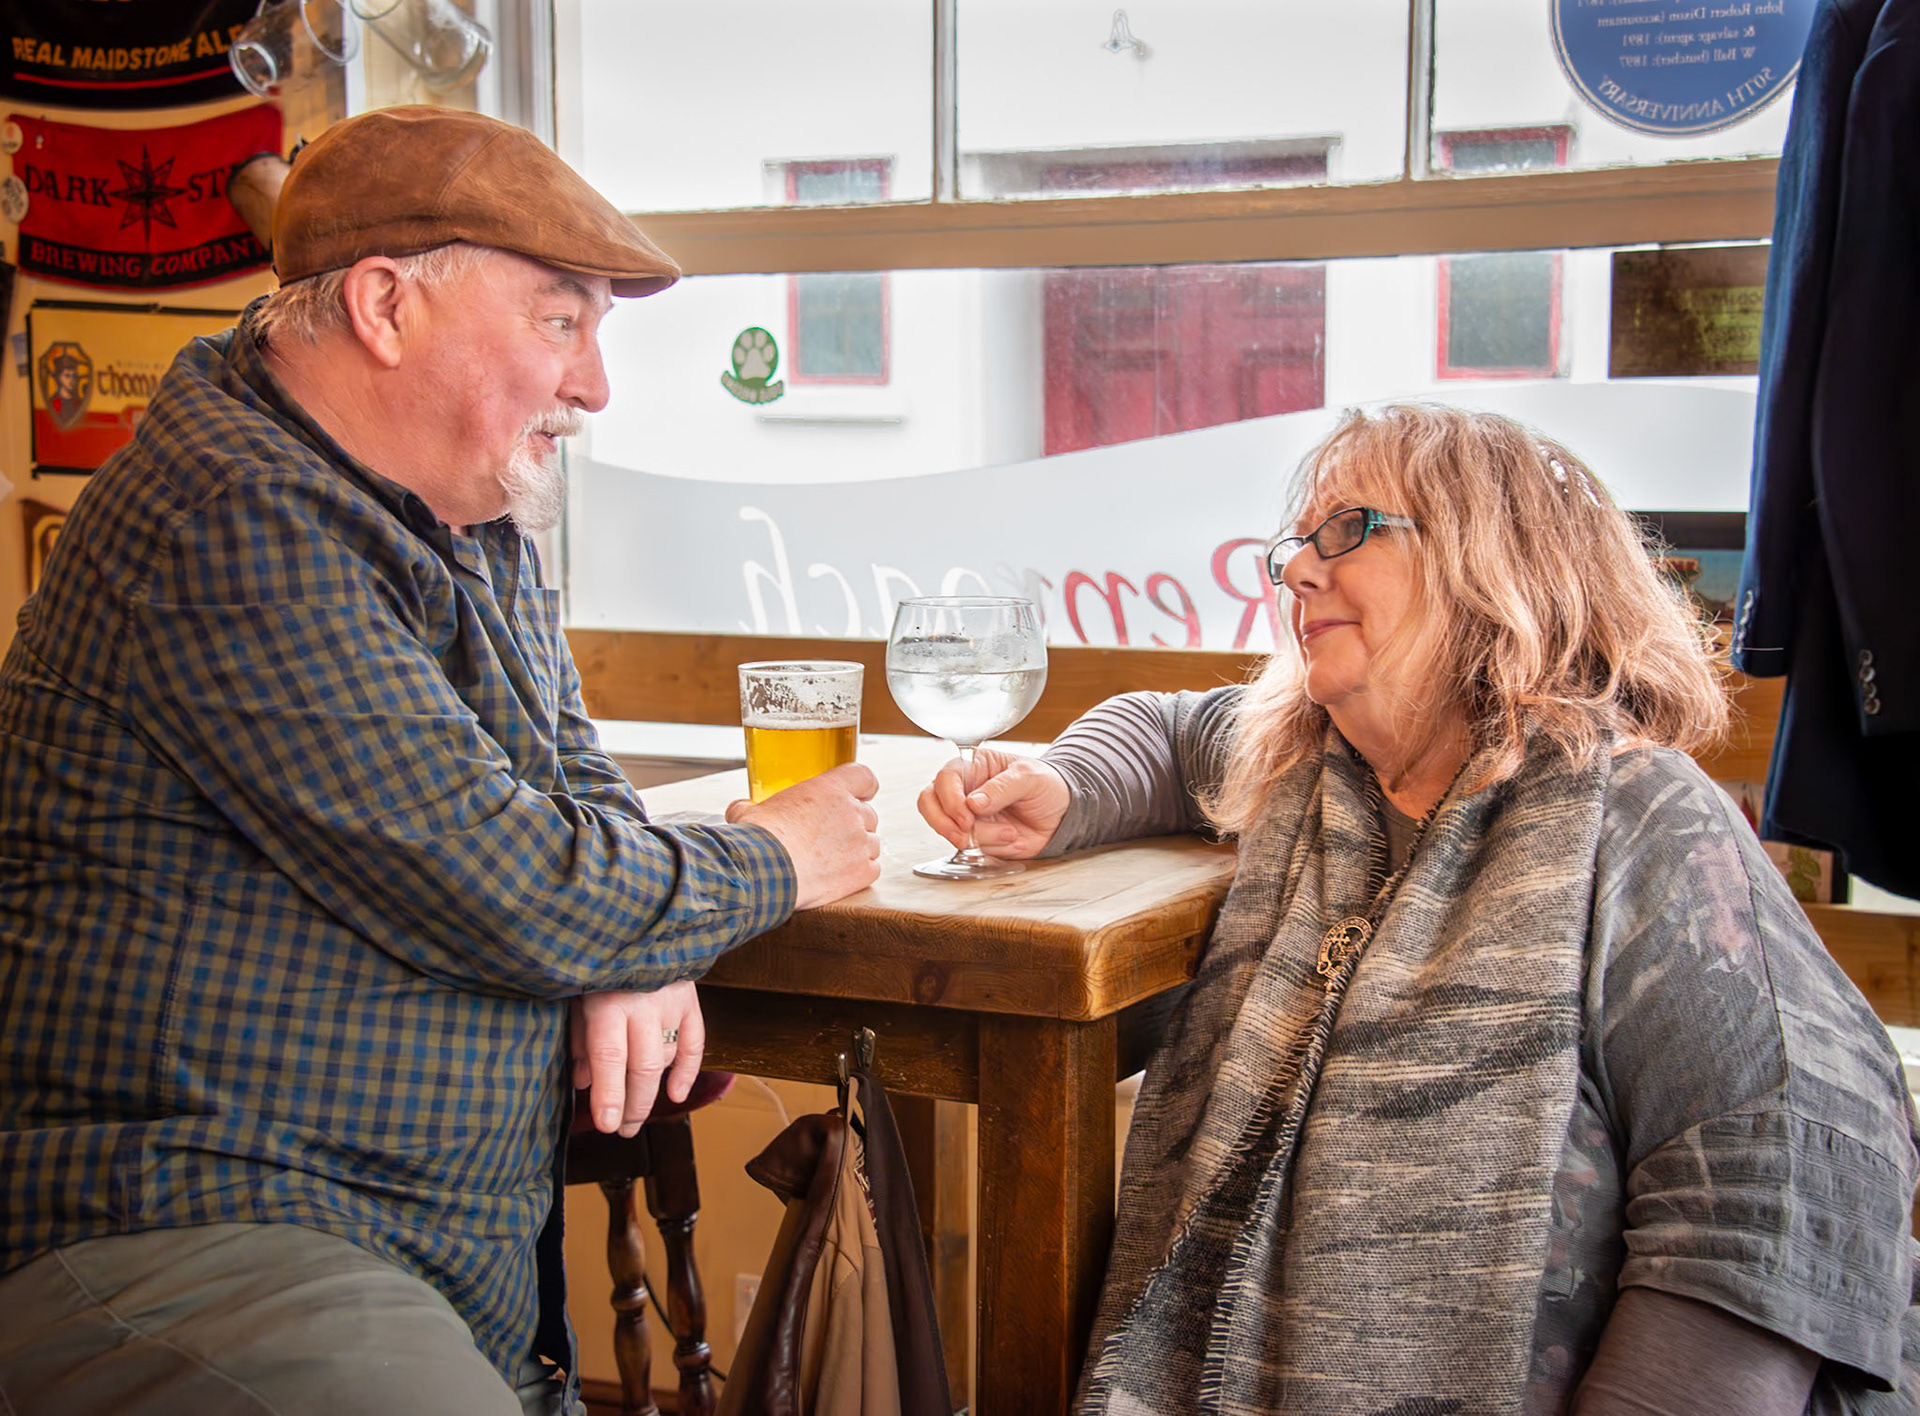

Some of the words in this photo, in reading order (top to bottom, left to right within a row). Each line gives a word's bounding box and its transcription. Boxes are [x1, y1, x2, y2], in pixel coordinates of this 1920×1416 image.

[11, 36, 66, 67] REAL
[70, 37, 192, 70] MAIDSTONE
[24, 164, 112, 207] DARK
[30, 240, 141, 277] BREWING
